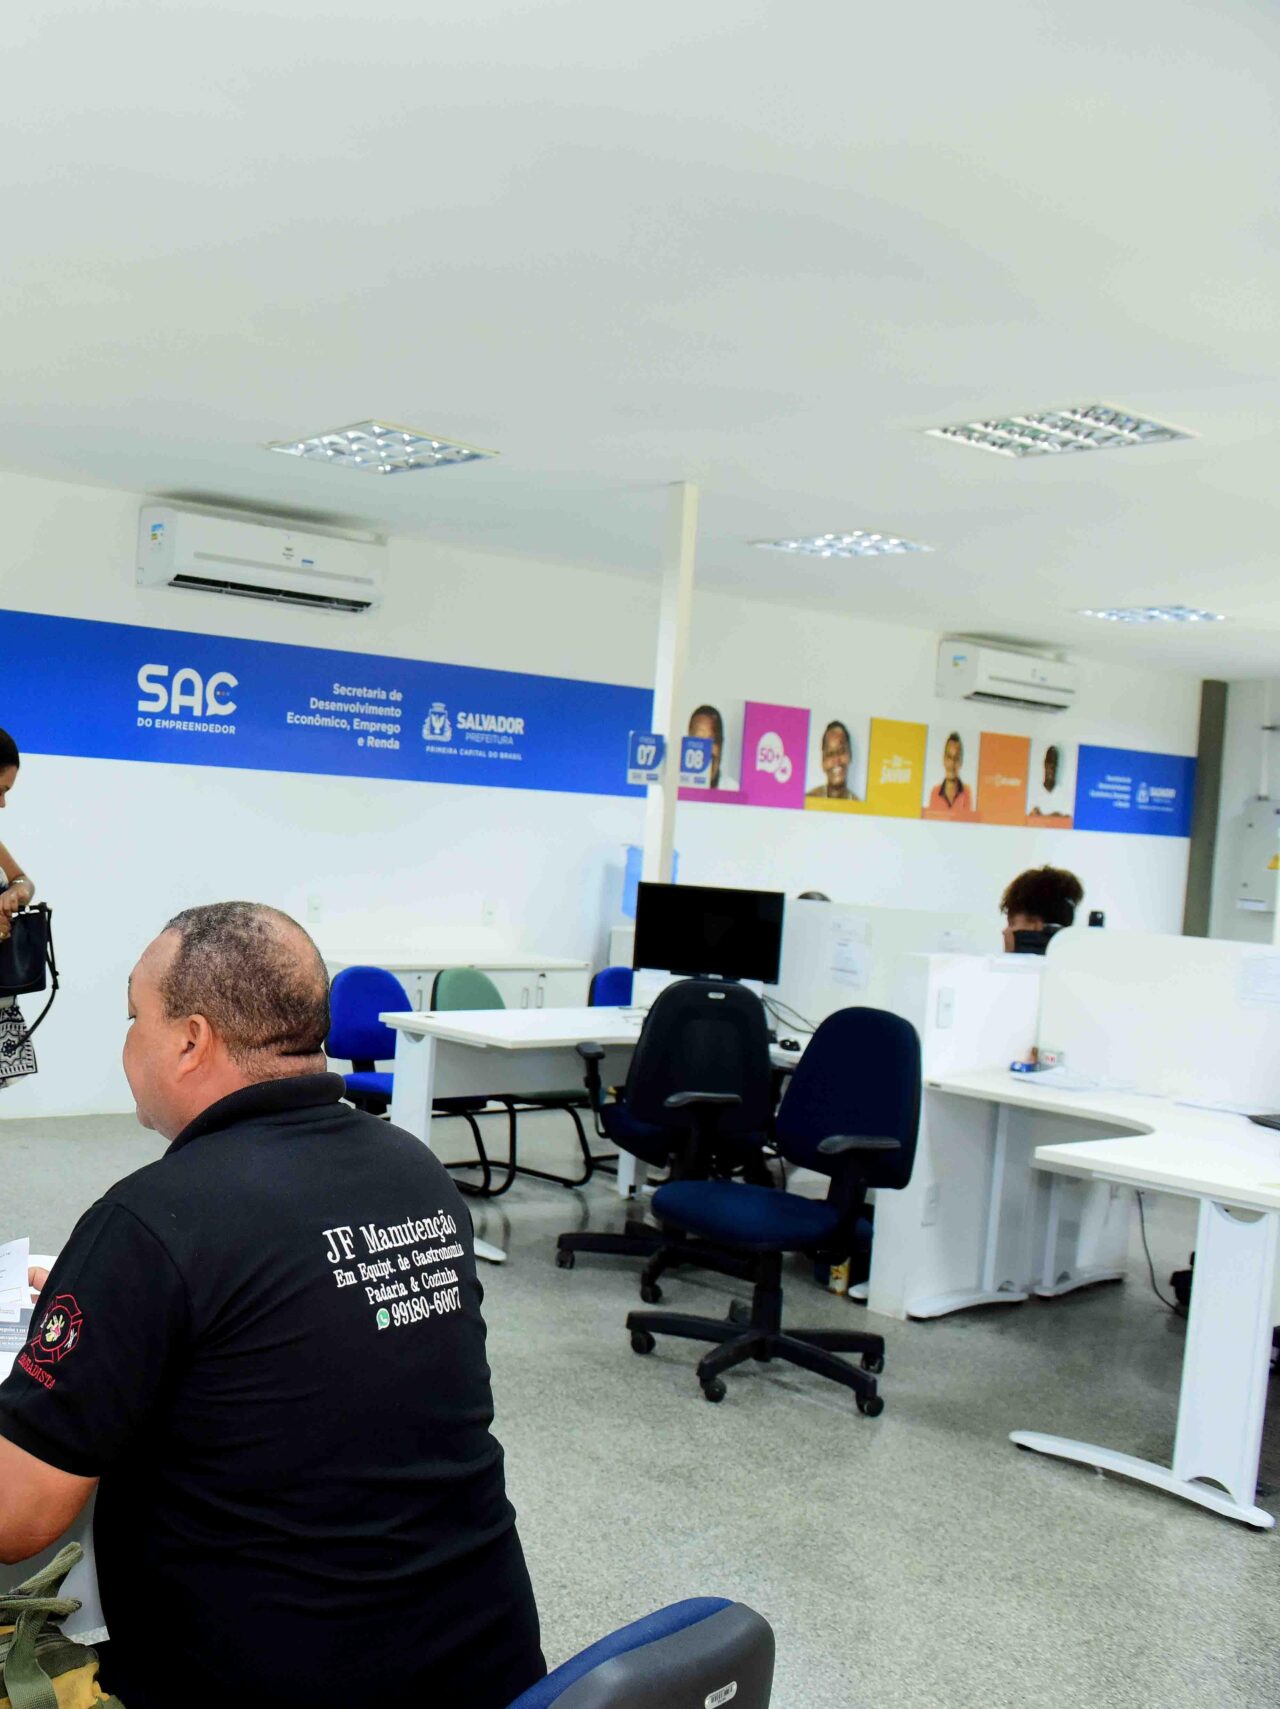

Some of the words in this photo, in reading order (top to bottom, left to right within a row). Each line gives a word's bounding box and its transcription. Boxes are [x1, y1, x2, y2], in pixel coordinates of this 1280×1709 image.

[137, 663, 239, 716] SAC
[333, 682, 387, 700] Secretaria
[389, 689, 403, 701] de
[310, 697, 402, 718] Desenvolvimento
[137, 717, 152, 727] DO
[155, 718, 236, 735] EMPREENDEDOR
[286, 711, 350, 731] Econômico,
[353, 718, 401, 735] Emprego
[456, 711, 524, 735] SALVADOR
[357, 736, 365, 747] e
[367, 735, 400, 750] Renda
[465, 731, 514, 746] PREFEITURA
[636, 745, 657, 766] 07
[685, 749, 705, 770] 08
[759, 748, 781, 763] 50+
[322, 1226, 356, 1264] JF
[359, 1209, 457, 1254] Manutenção
[333, 1269, 359, 1288] Em
[357, 1258, 397, 1282] Equipt.
[397, 1254, 411, 1271] de
[411, 1241, 465, 1267] Gastronomia
[365, 1280, 409, 1305] Padaria
[410, 1276, 421, 1293] &
[421, 1267, 459, 1290] Cozinha
[391, 1286, 462, 1327] 99180-6007
